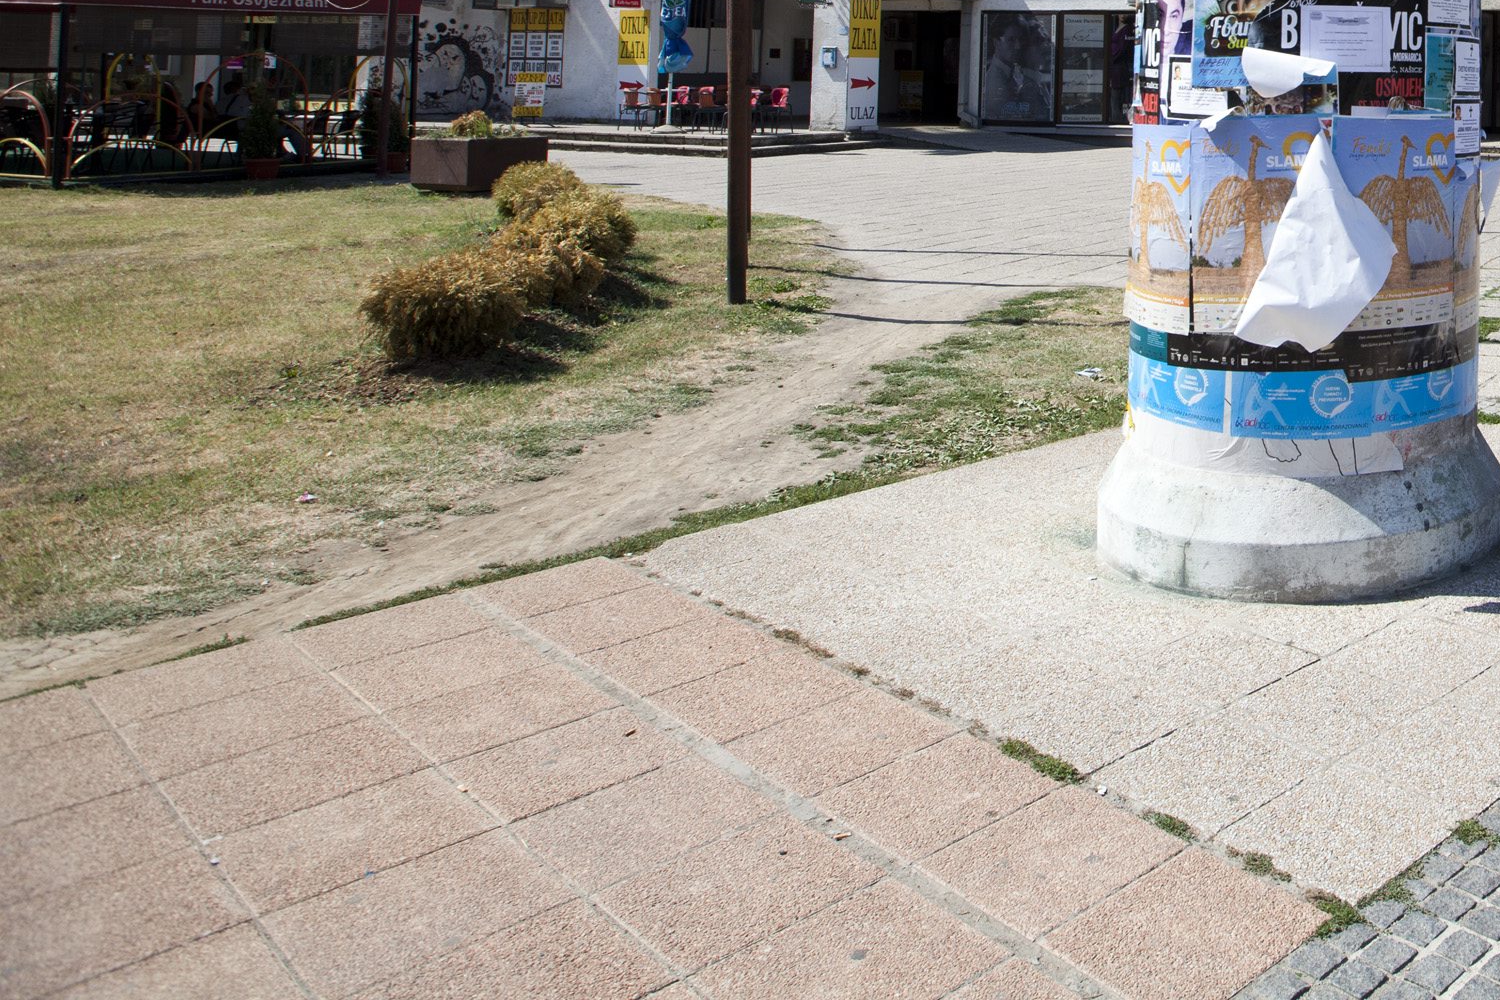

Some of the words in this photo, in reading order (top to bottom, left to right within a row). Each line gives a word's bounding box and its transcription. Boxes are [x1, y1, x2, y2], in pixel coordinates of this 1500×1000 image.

[621, 16, 647, 35] OTKUP
[852, 28, 877, 50] ZLATA
[620, 41, 645, 59] ZLATA
[1400, 66, 1423, 74] NAŠICE
[850, 106, 875, 120] ULAZ
[1152, 160, 1182, 174] SLAMA
[1412, 155, 1448, 168] SLAMA
